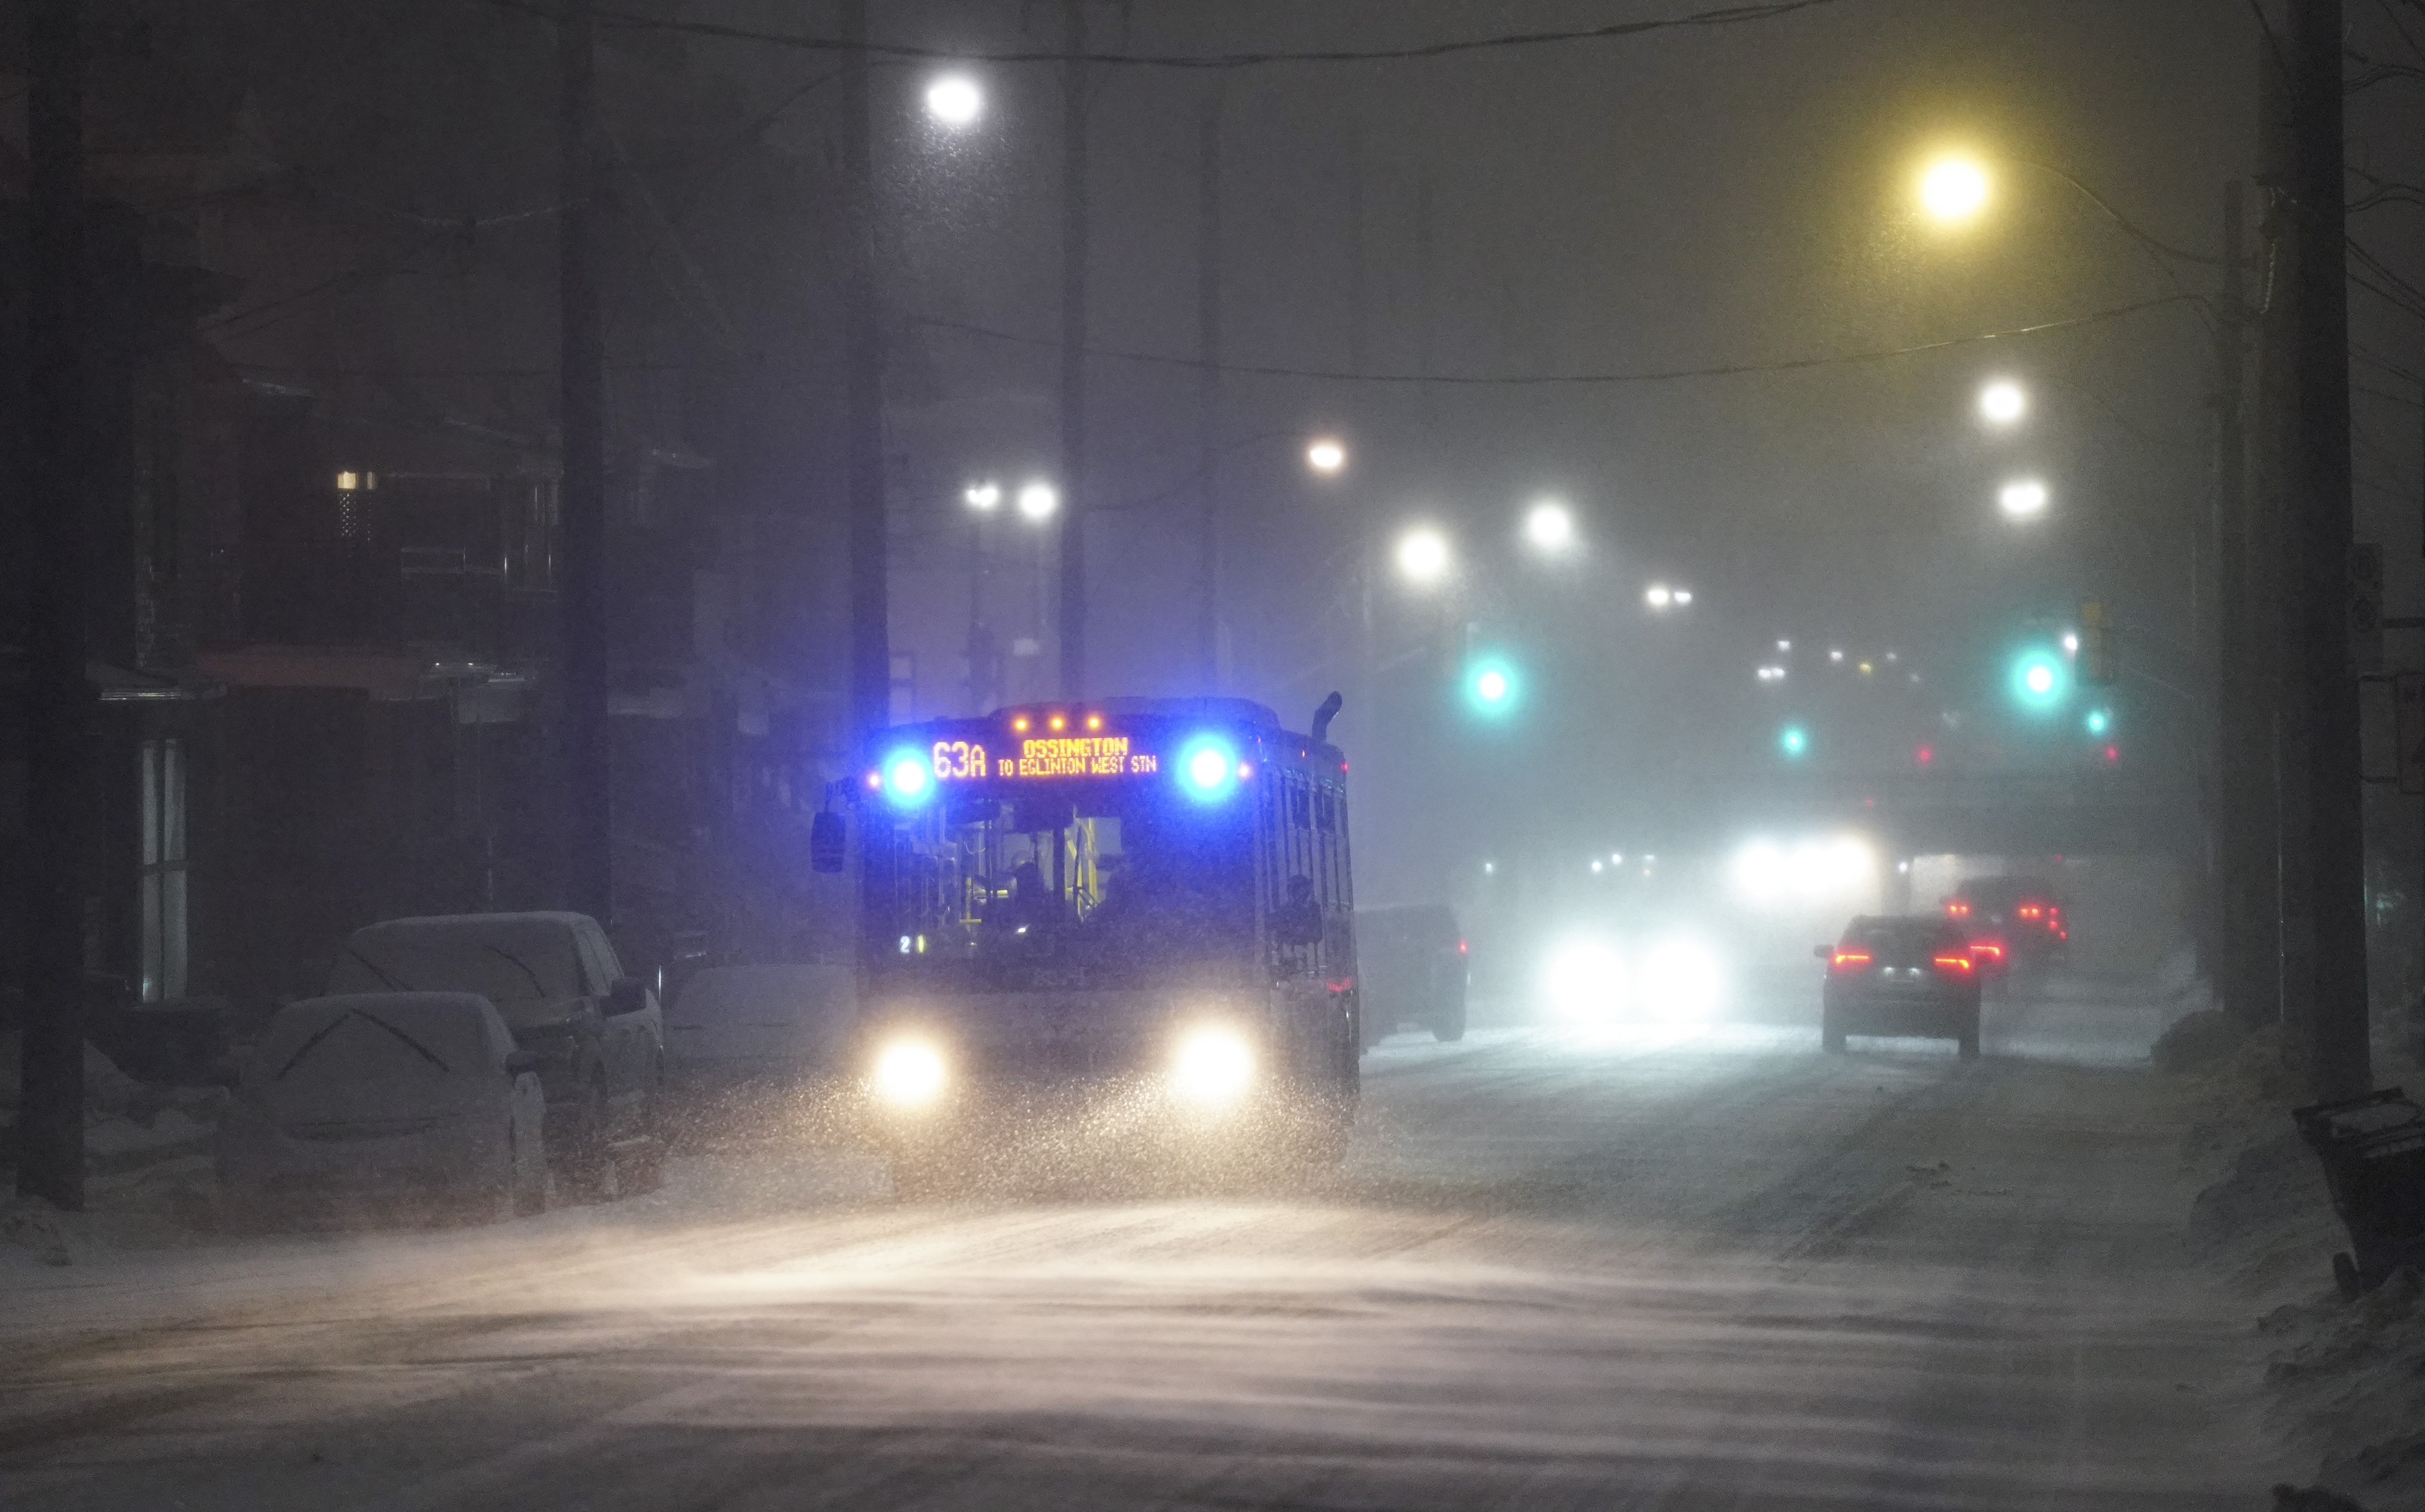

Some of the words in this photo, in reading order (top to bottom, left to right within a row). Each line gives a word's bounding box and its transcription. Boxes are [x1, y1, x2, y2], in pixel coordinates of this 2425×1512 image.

[1024, 737, 1127, 758] OSSINGTON
[933, 741, 986, 778] 63A
[998, 759, 1014, 776] TO
[1019, 757, 1086, 775] EGLINTON
[1090, 756, 1125, 774] WEST
[1131, 755, 1156, 773] STN
